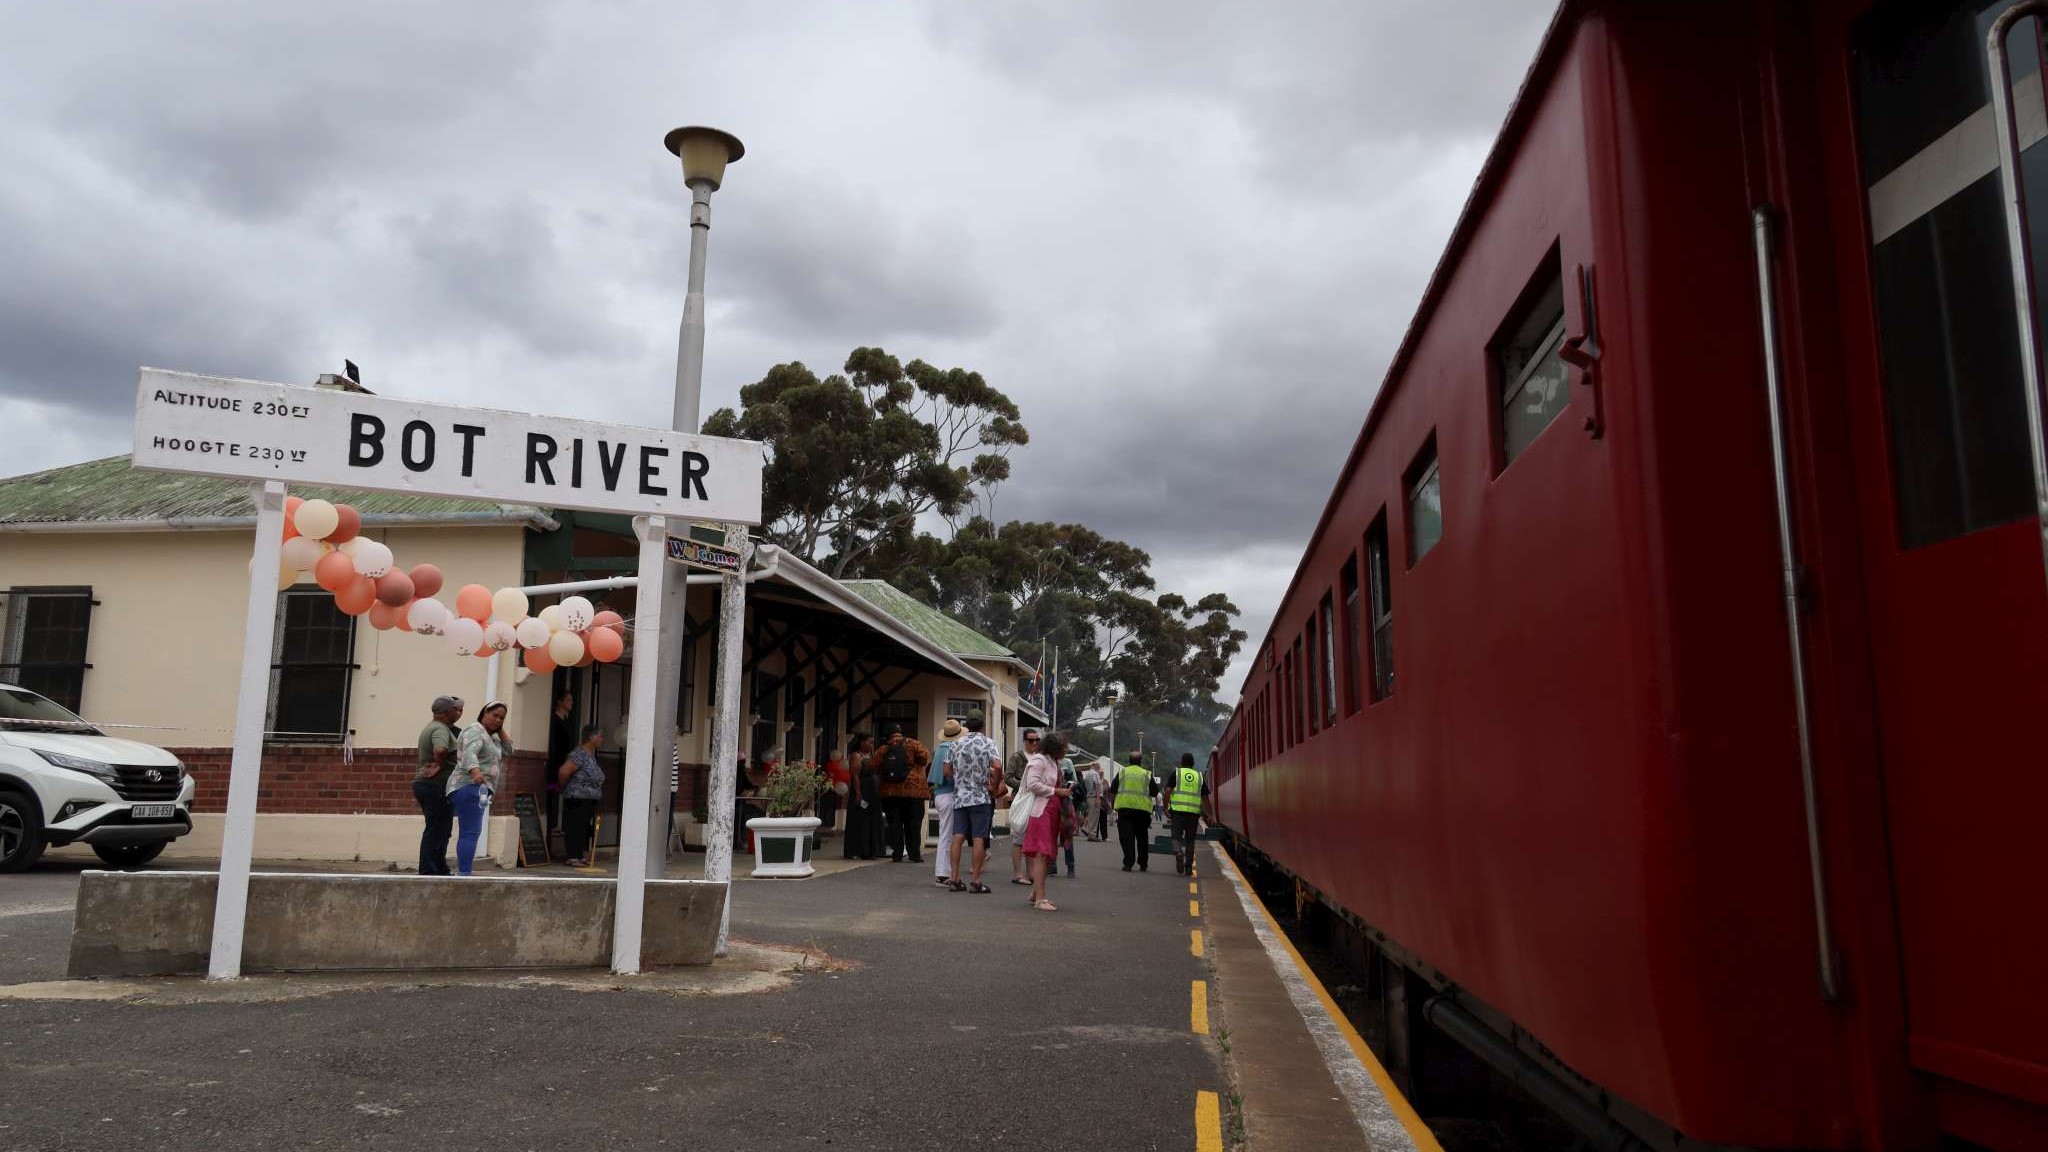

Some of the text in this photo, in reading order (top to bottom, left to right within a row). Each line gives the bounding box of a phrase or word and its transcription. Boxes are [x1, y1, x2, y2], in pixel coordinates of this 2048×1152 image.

[153, 389, 243, 412] ALTITUDE
[153, 435, 241, 457] HOOGTE
[348, 412, 711, 502] BOT RIVER
